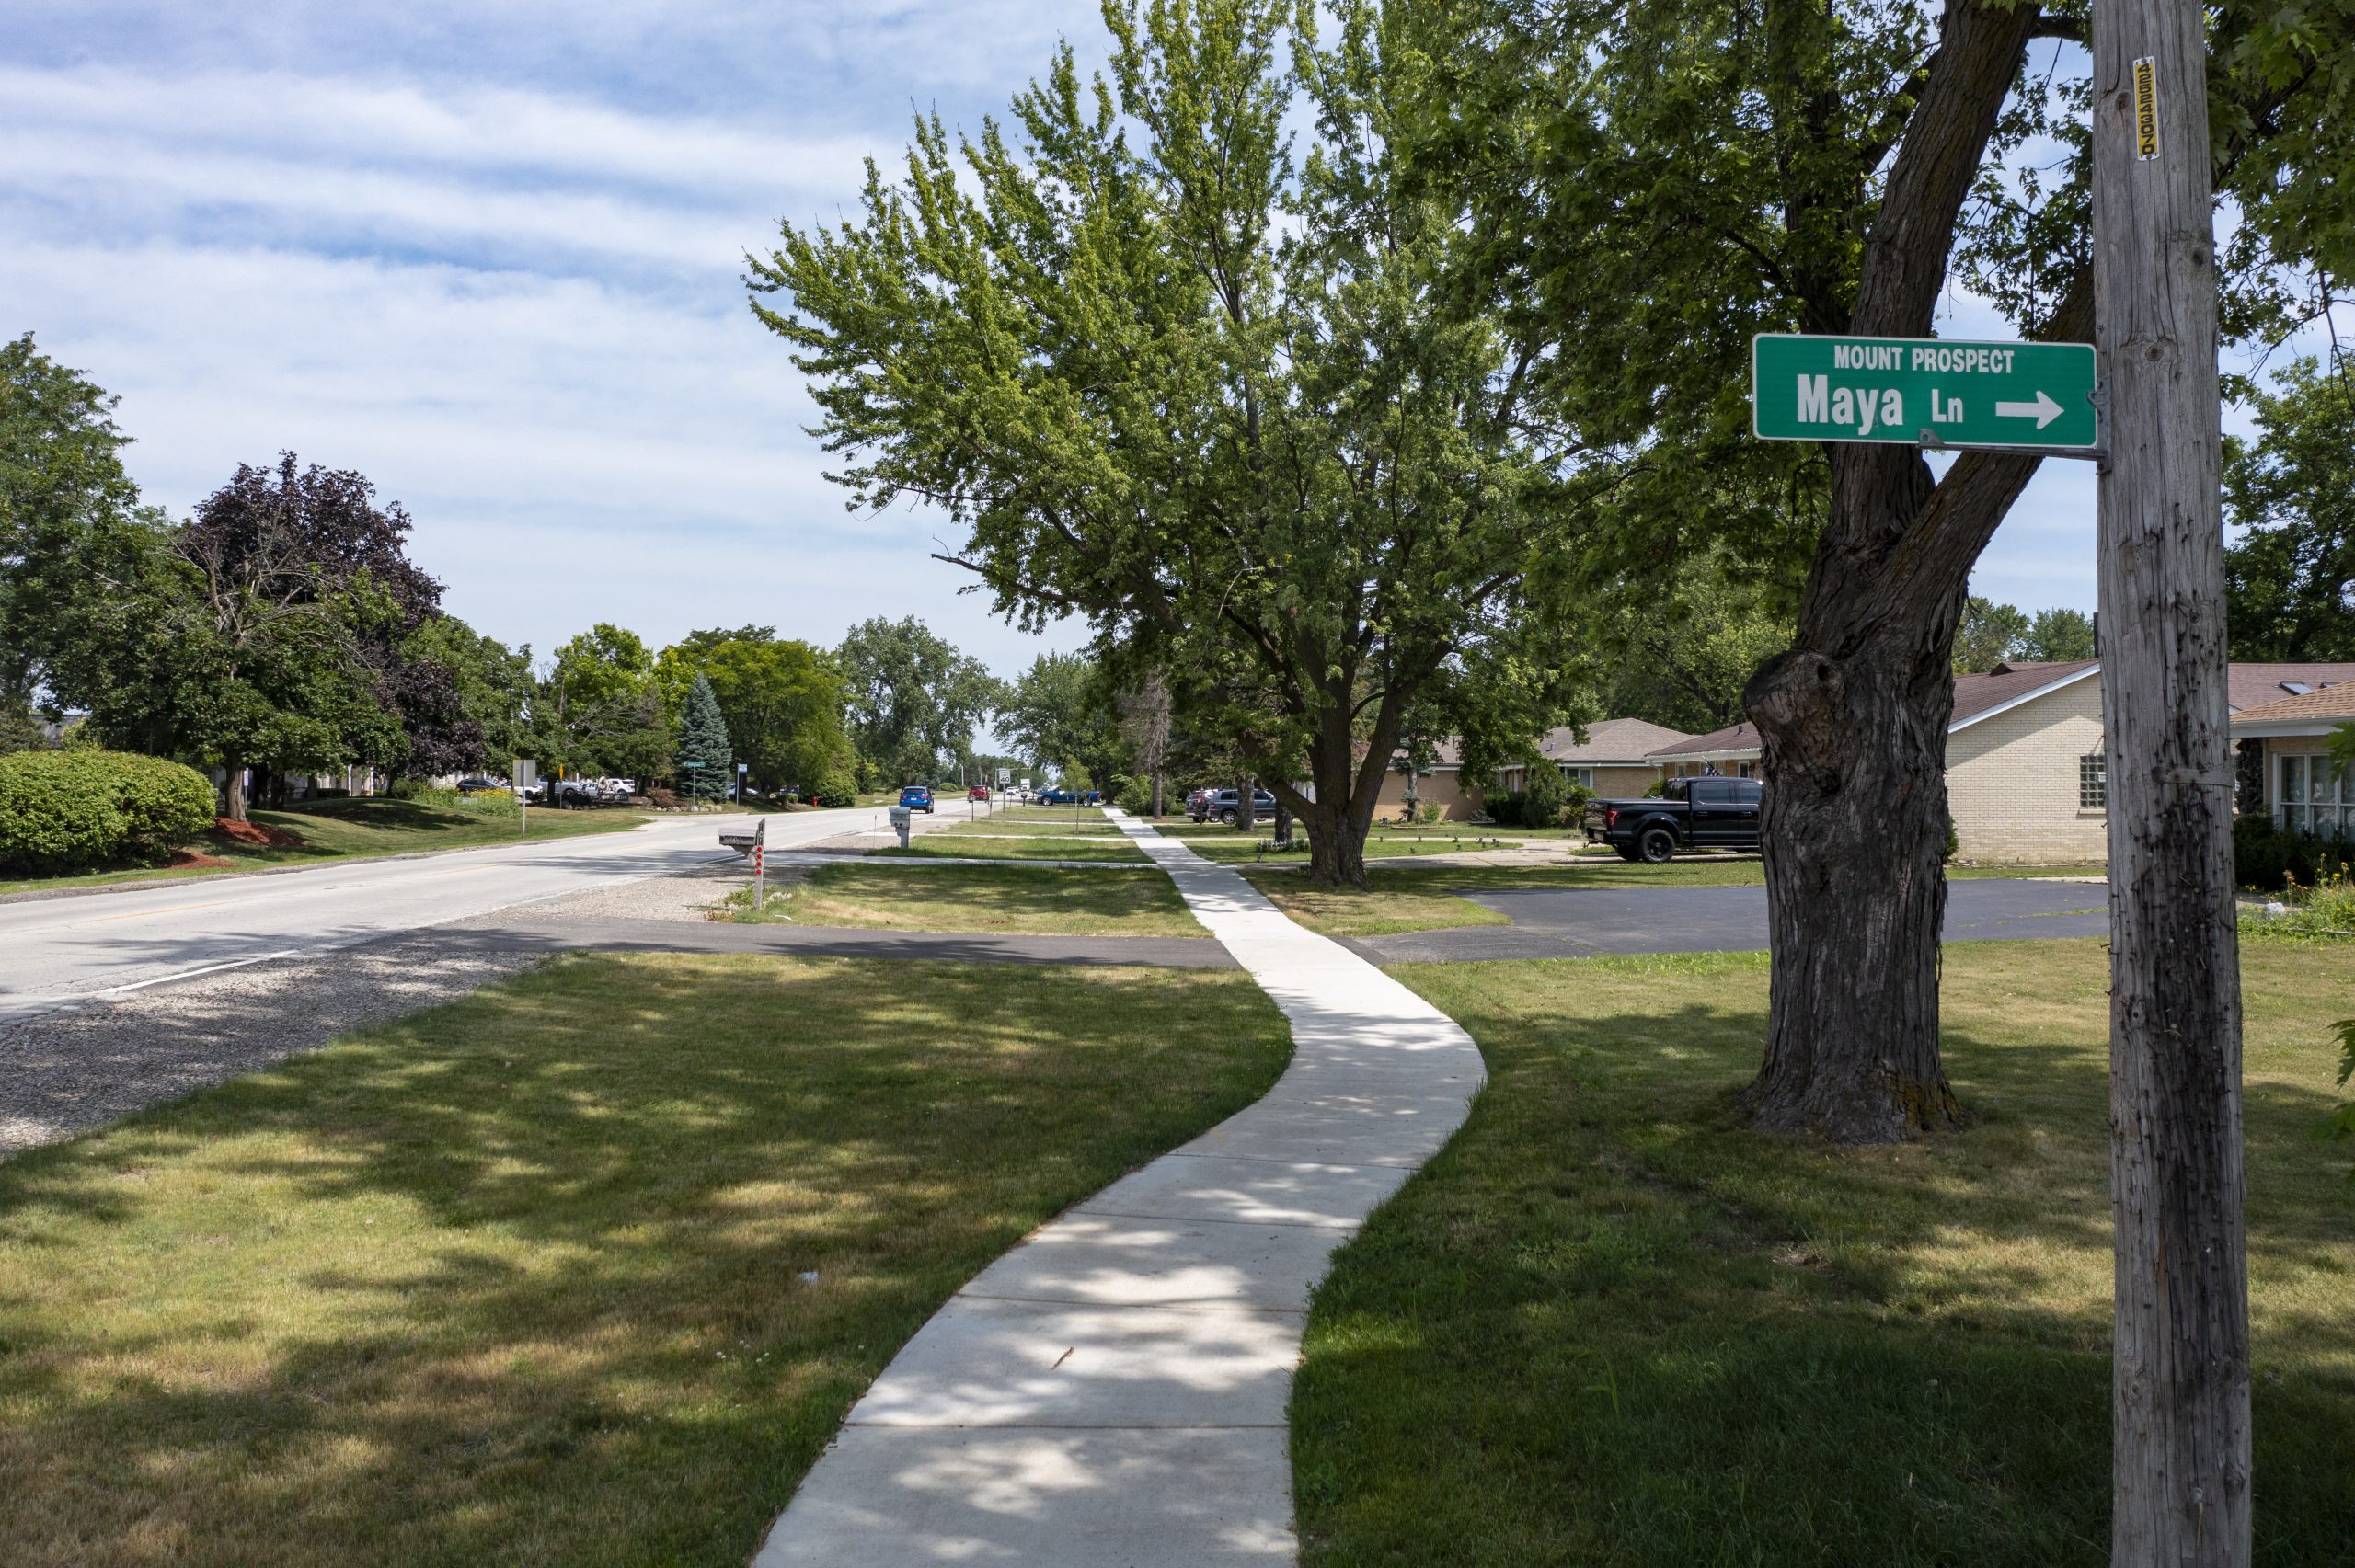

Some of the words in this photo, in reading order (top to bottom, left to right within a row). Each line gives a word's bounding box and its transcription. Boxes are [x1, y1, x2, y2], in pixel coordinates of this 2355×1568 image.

[2137, 63, 2155, 155] 425243070
[1834, 345, 1903, 371] MOUNT
[1912, 348, 2015, 373] PROSPECT
[1798, 374, 1903, 436] Maya
[1932, 389, 1963, 423] Ln
